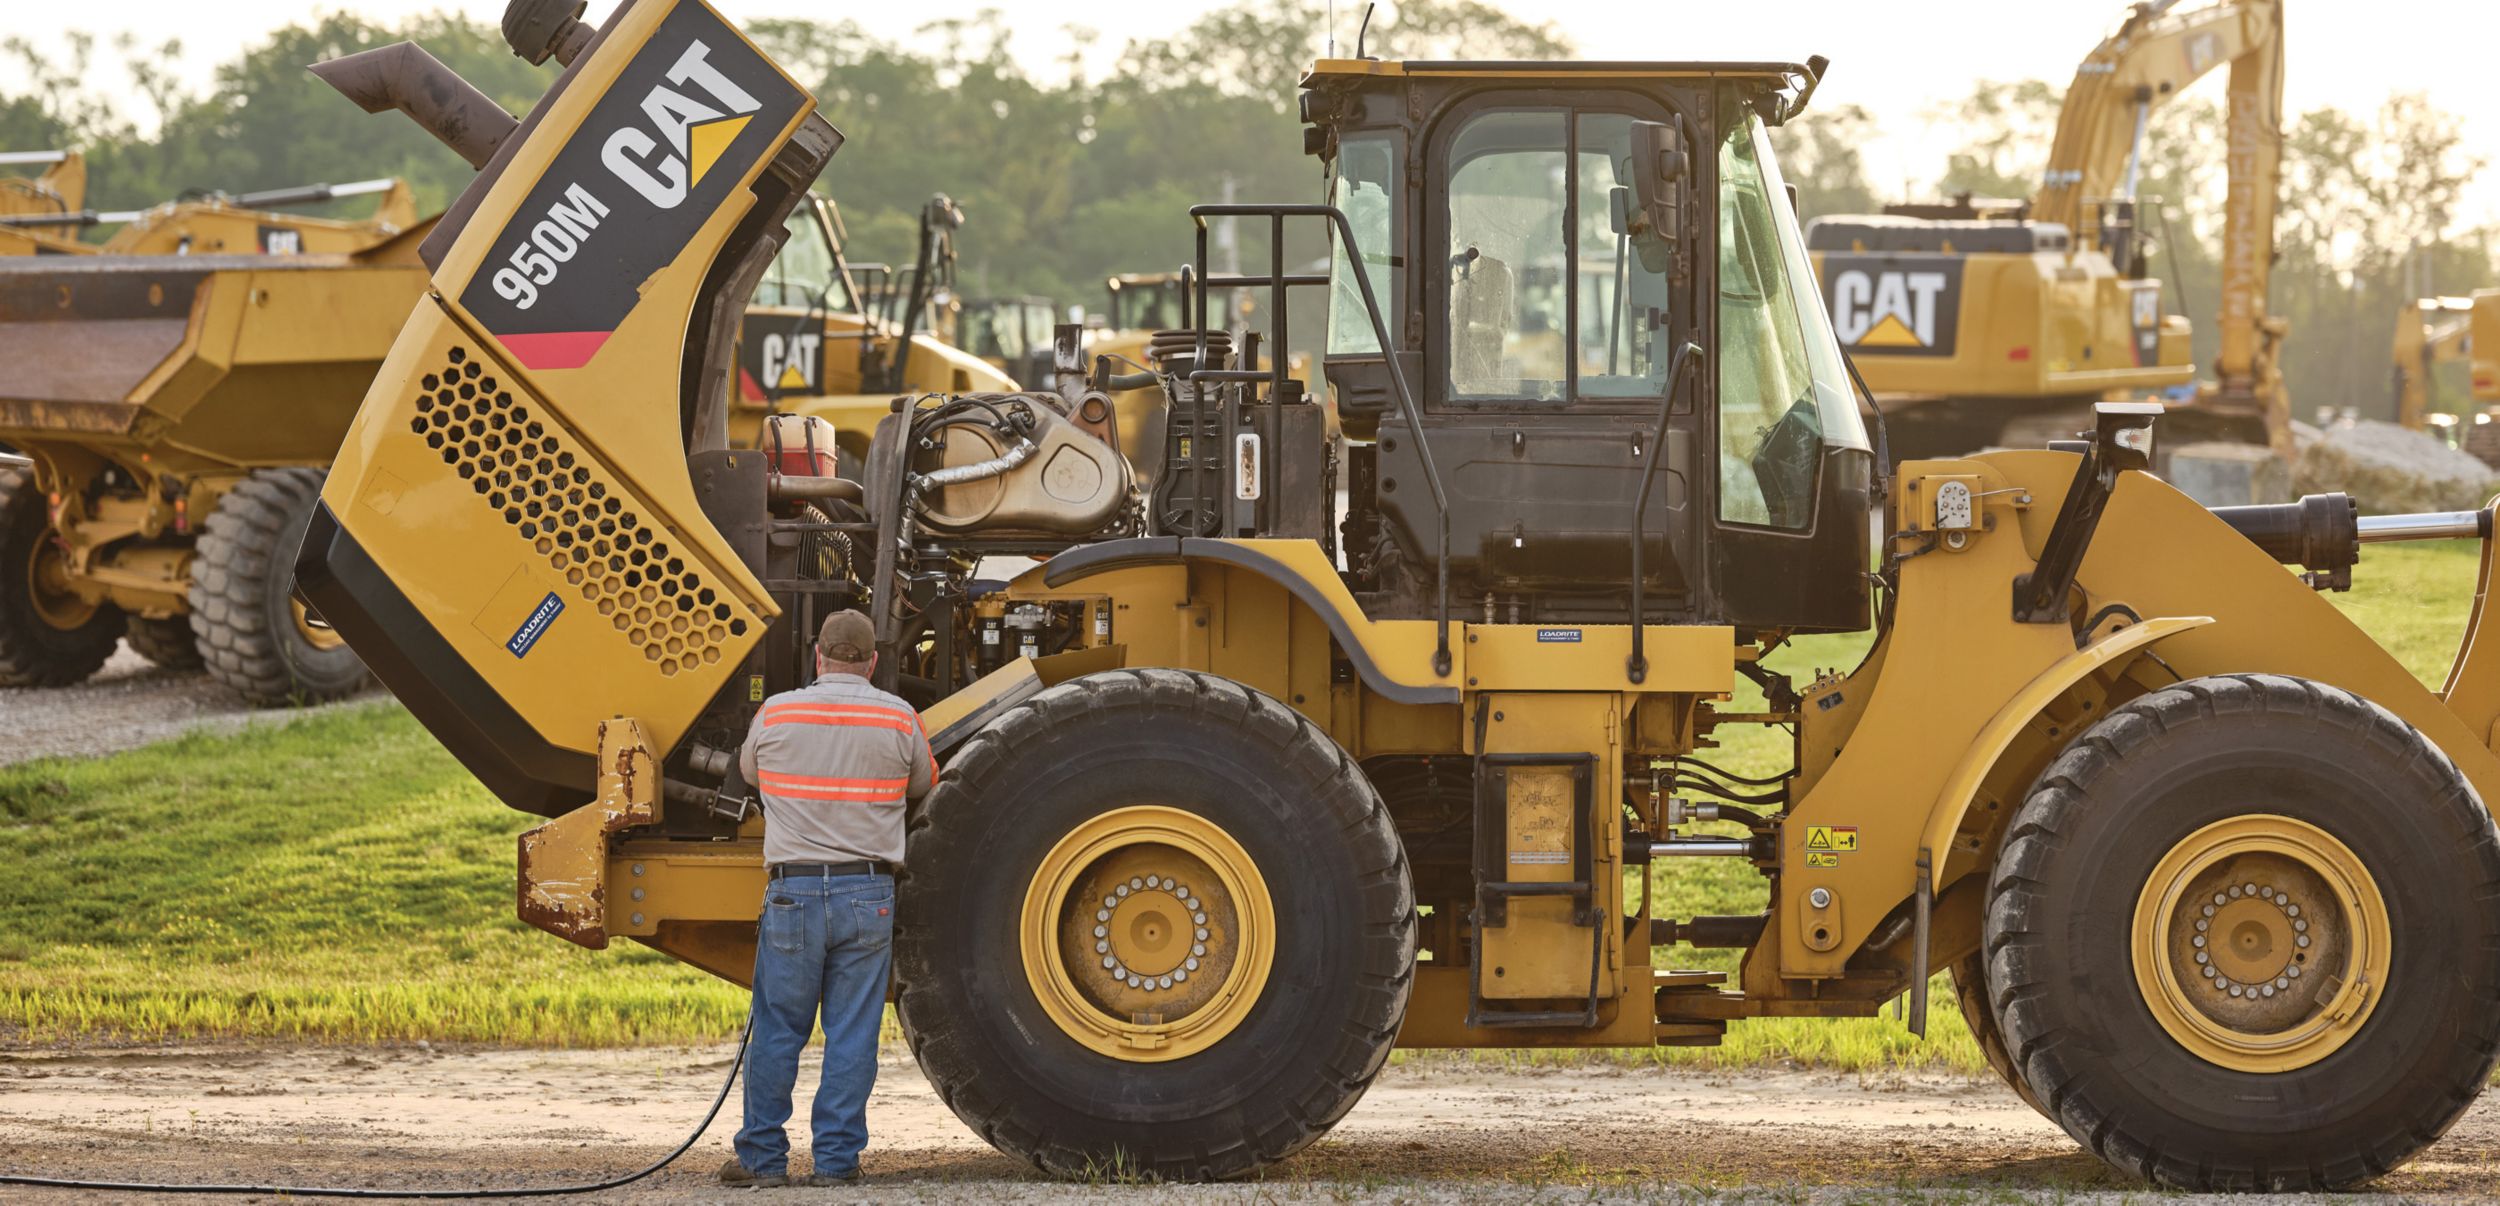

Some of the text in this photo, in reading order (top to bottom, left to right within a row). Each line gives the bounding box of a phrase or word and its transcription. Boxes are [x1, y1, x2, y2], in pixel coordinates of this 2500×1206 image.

[601, 38, 763, 209] CAT
[492, 182, 611, 310] 950M
[1833, 269, 1946, 347] CAT
[763, 333, 820, 389] CAT
[512, 595, 557, 650] LOADRITE
[1023, 635, 1036, 644] CAT
